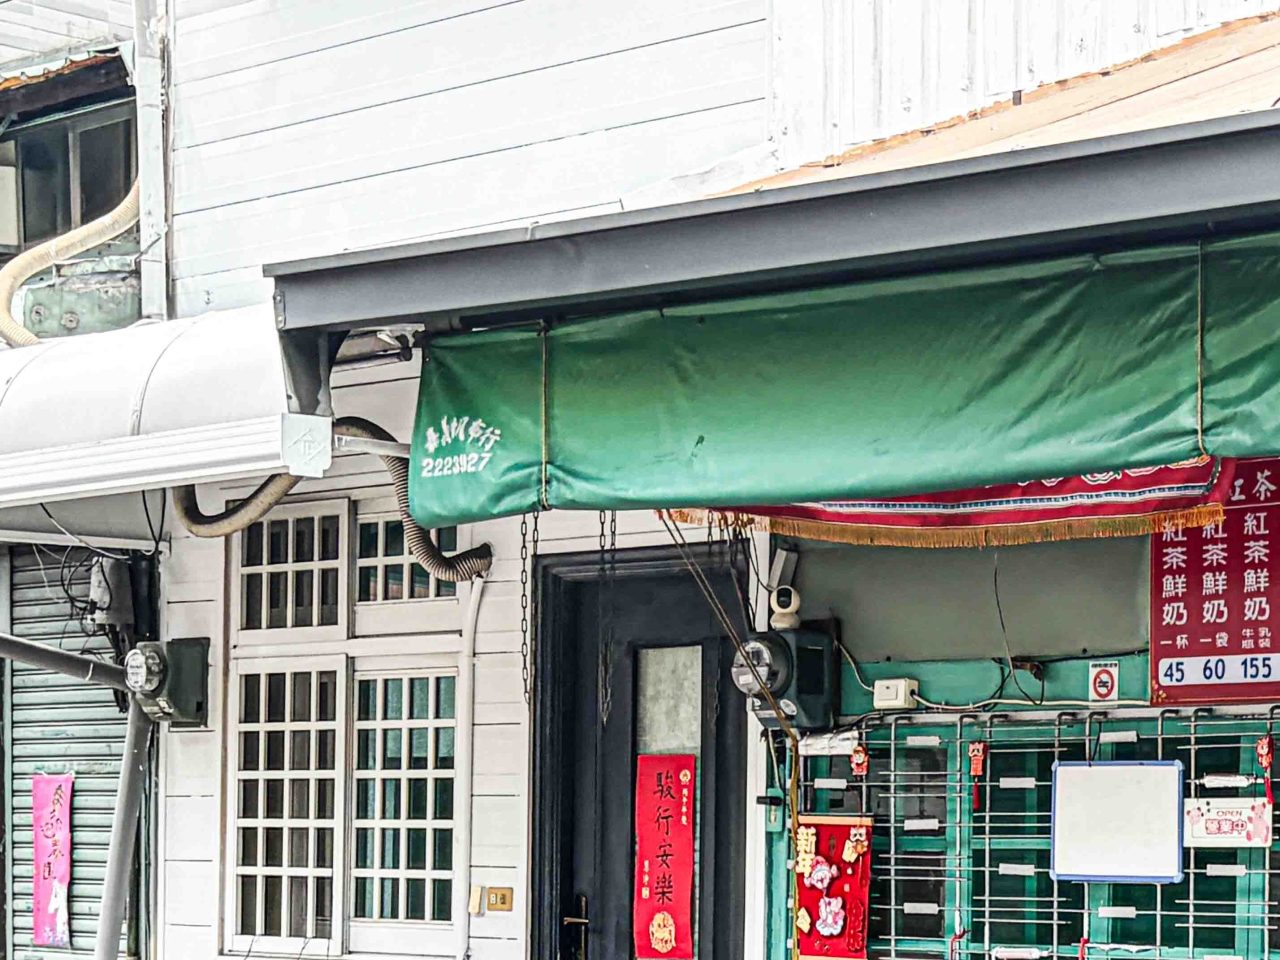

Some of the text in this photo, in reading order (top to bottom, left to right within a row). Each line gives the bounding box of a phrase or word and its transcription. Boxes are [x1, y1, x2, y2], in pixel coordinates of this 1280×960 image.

[1162, 517, 1188, 626] 紅茶鮮奶
[1202, 515, 1229, 624] 紅茶鮮奶
[1243, 511, 1271, 622] 紅茶鮮奶
[1160, 634, 1190, 650] 一杯
[1200, 632, 1229, 648] 一袋
[1163, 661, 1185, 683] 45
[1203, 658, 1226, 680] 60
[1240, 656, 1272, 679] 155
